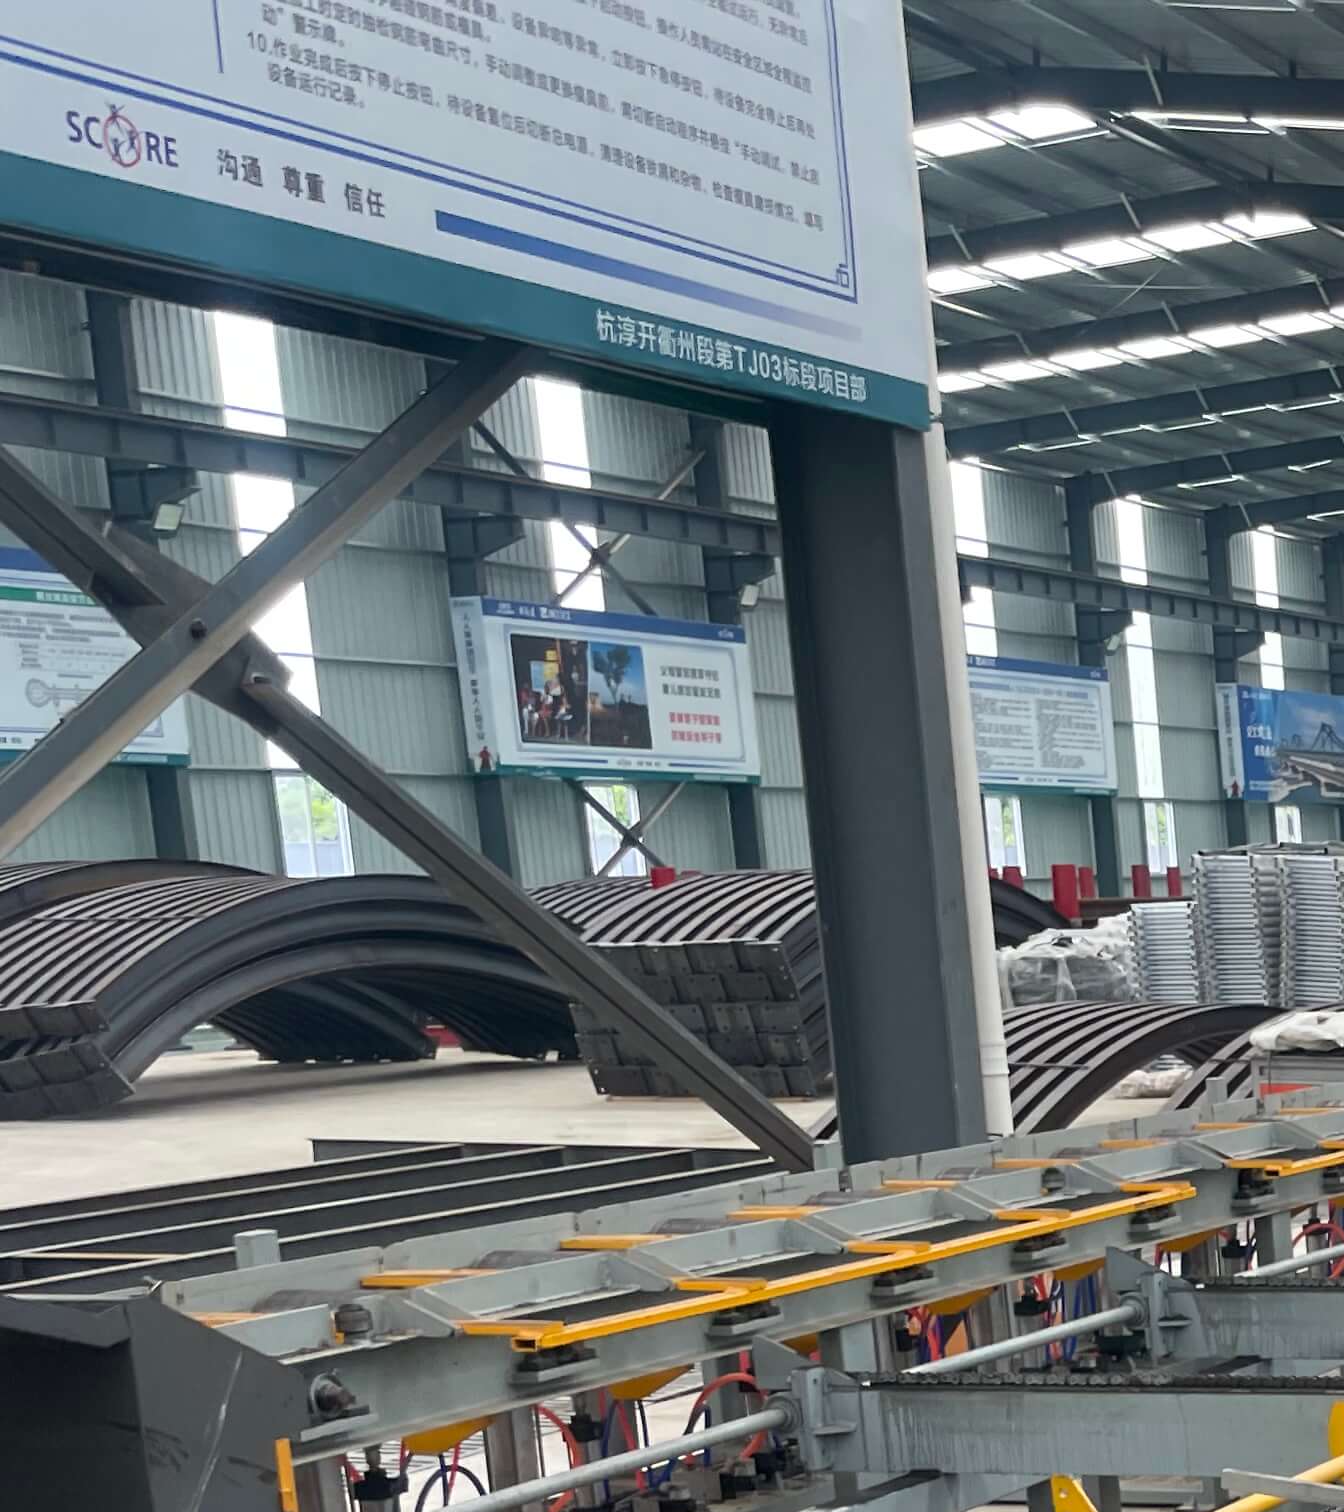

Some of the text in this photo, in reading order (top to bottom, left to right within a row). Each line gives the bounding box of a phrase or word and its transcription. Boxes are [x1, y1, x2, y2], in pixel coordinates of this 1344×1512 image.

[216, 149, 386, 219] 沟通 尊重 信任
